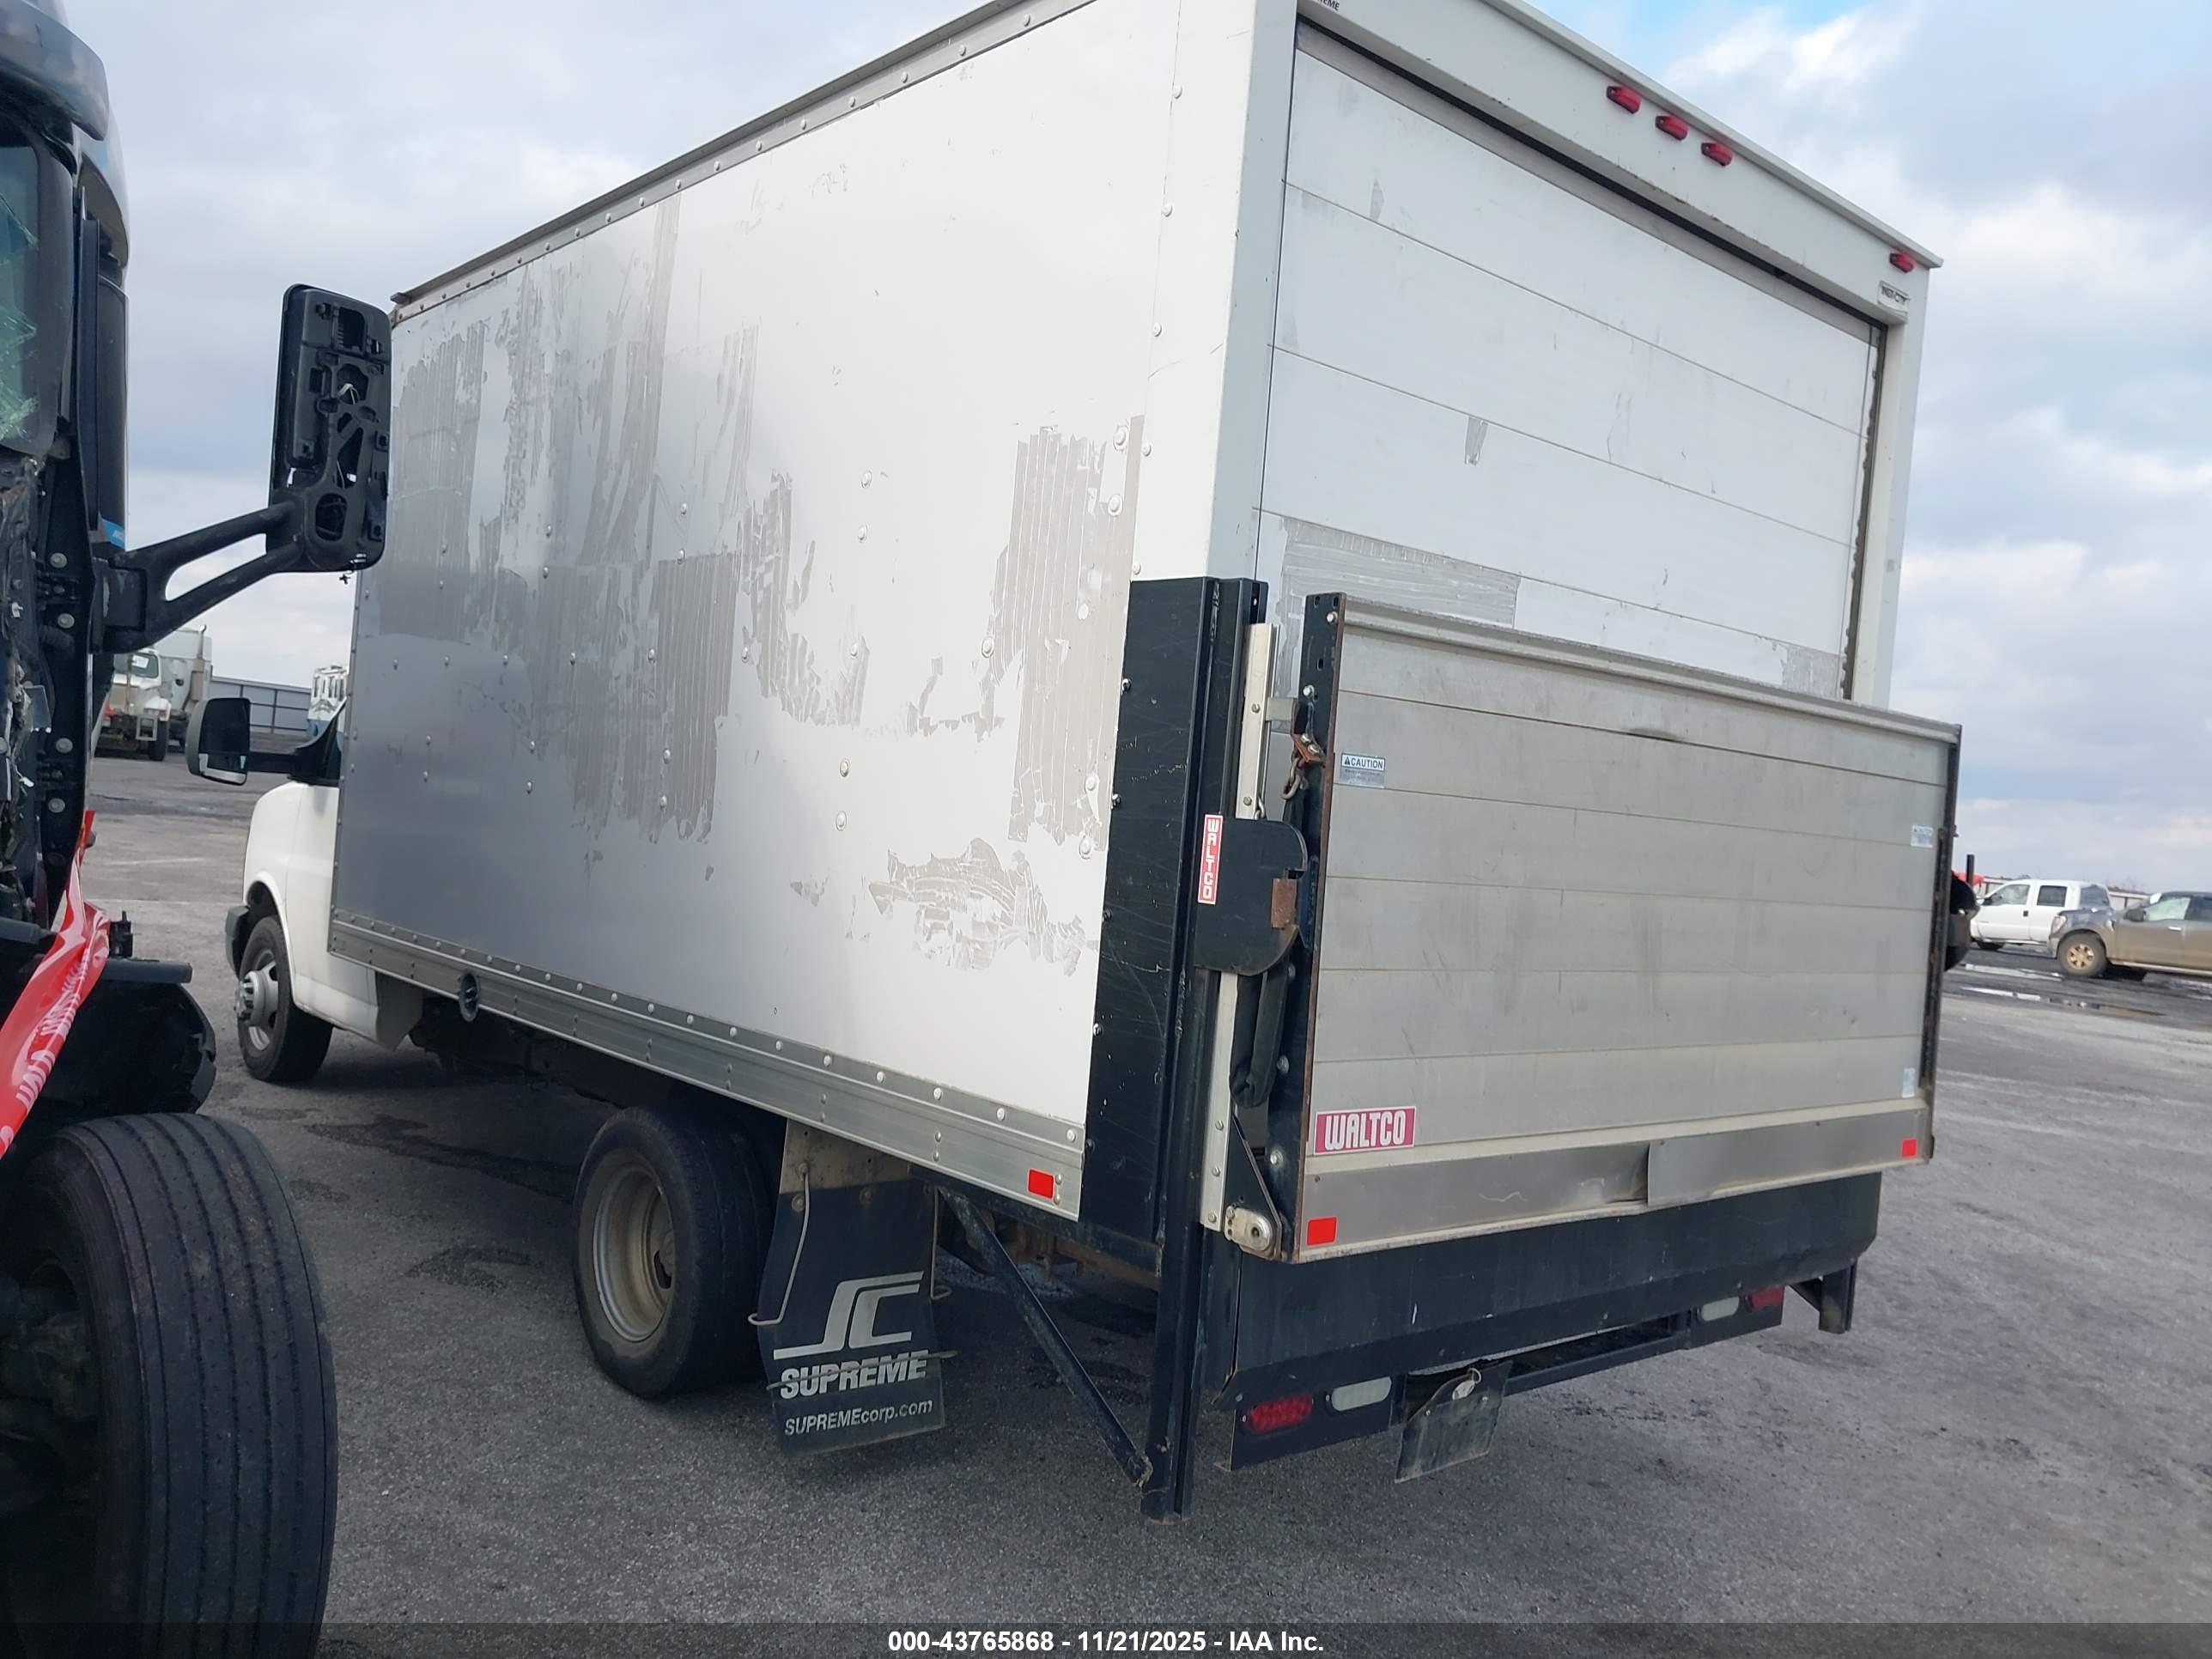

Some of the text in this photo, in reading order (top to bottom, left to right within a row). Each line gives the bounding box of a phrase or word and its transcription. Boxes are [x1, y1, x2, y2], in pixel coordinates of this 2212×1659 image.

[1351, 757, 1383, 769] CAUTION
[1203, 818, 1219, 899] WALTCO
[1325, 1110, 1406, 1151] WALTCO
[780, 1350, 929, 1399] SUPREME
[784, 1400, 933, 1436] SUPREMEcorp.com
